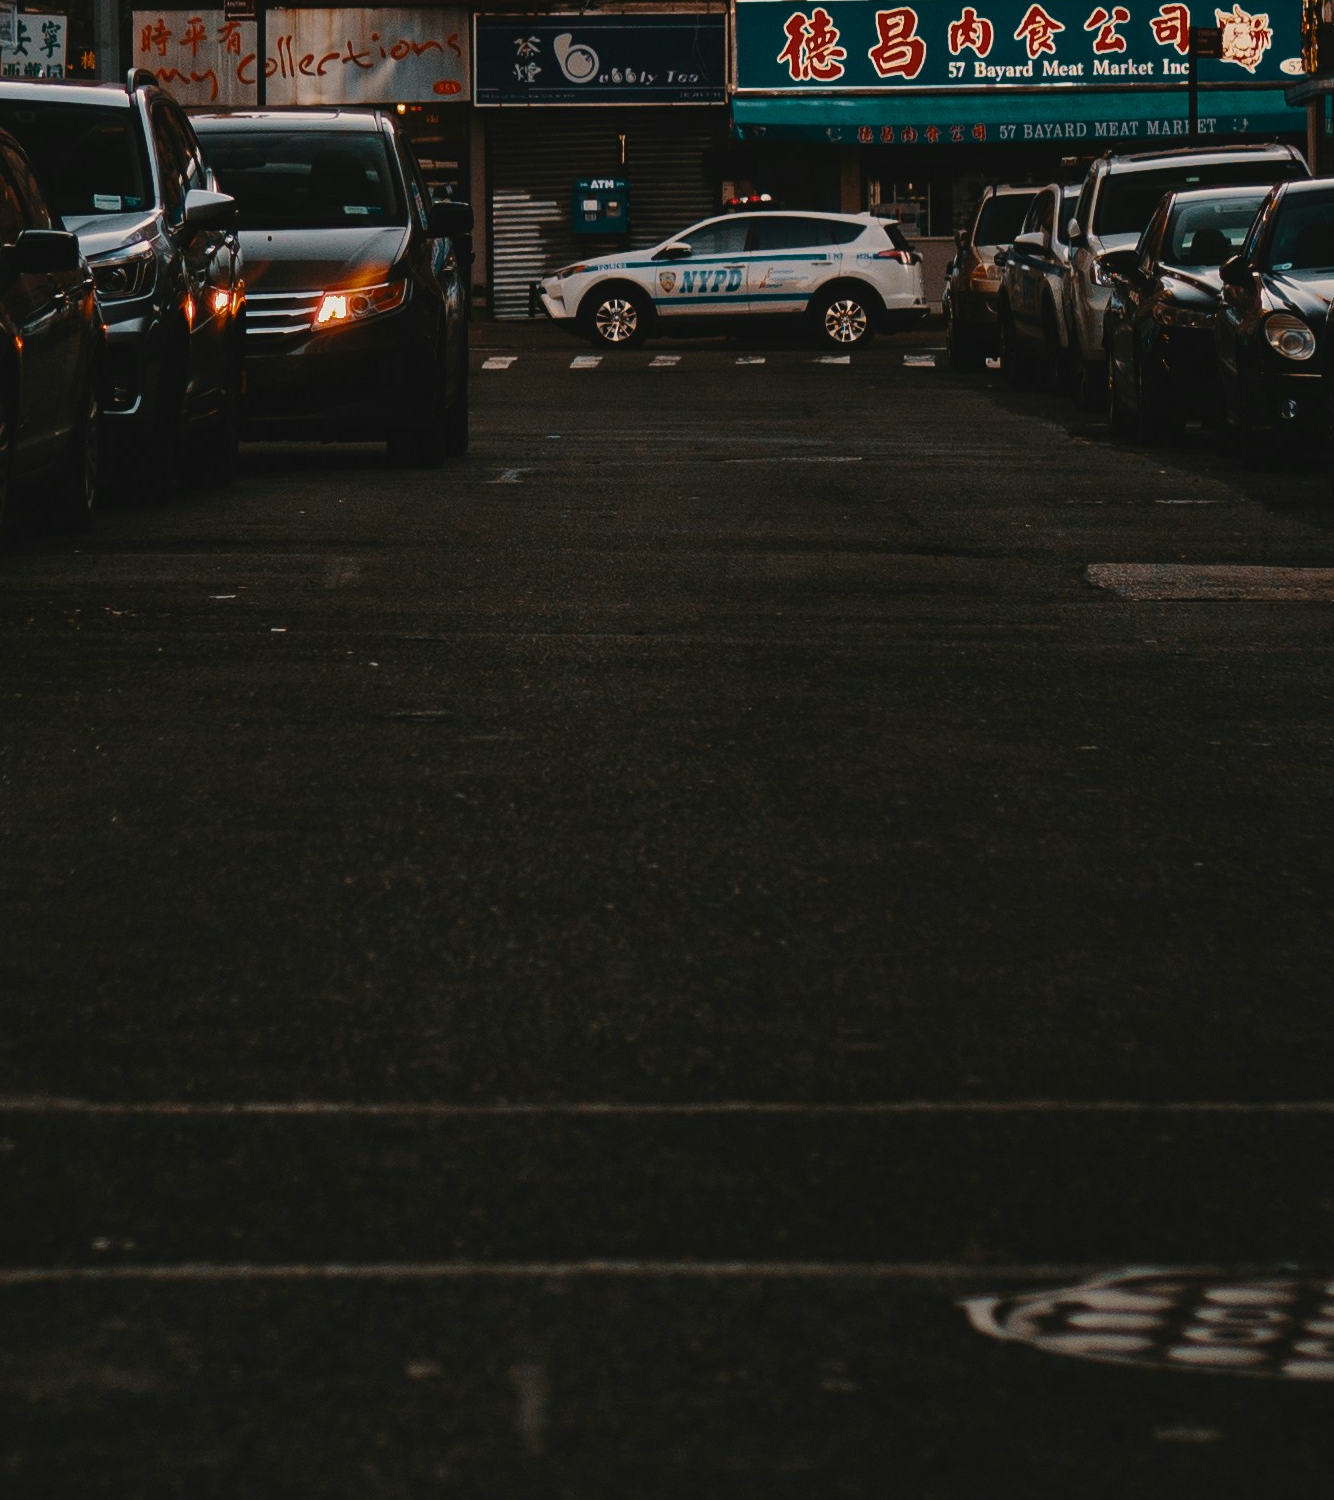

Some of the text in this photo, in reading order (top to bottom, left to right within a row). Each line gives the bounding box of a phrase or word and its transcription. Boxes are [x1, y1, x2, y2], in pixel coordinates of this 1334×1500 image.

[777, 2, 1192, 83] 德昌肉食公司
[948, 58, 1190, 81] 57 Bayard Meat Market Inc
[999, 124, 1017, 140] 57
[1023, 122, 1088, 140] BAYARD
[1094, 120, 1140, 138] MEAT
[590, 179, 615, 189] ATM
[597, 263, 627, 271] POLICE
[678, 268, 743, 294] NYPD
